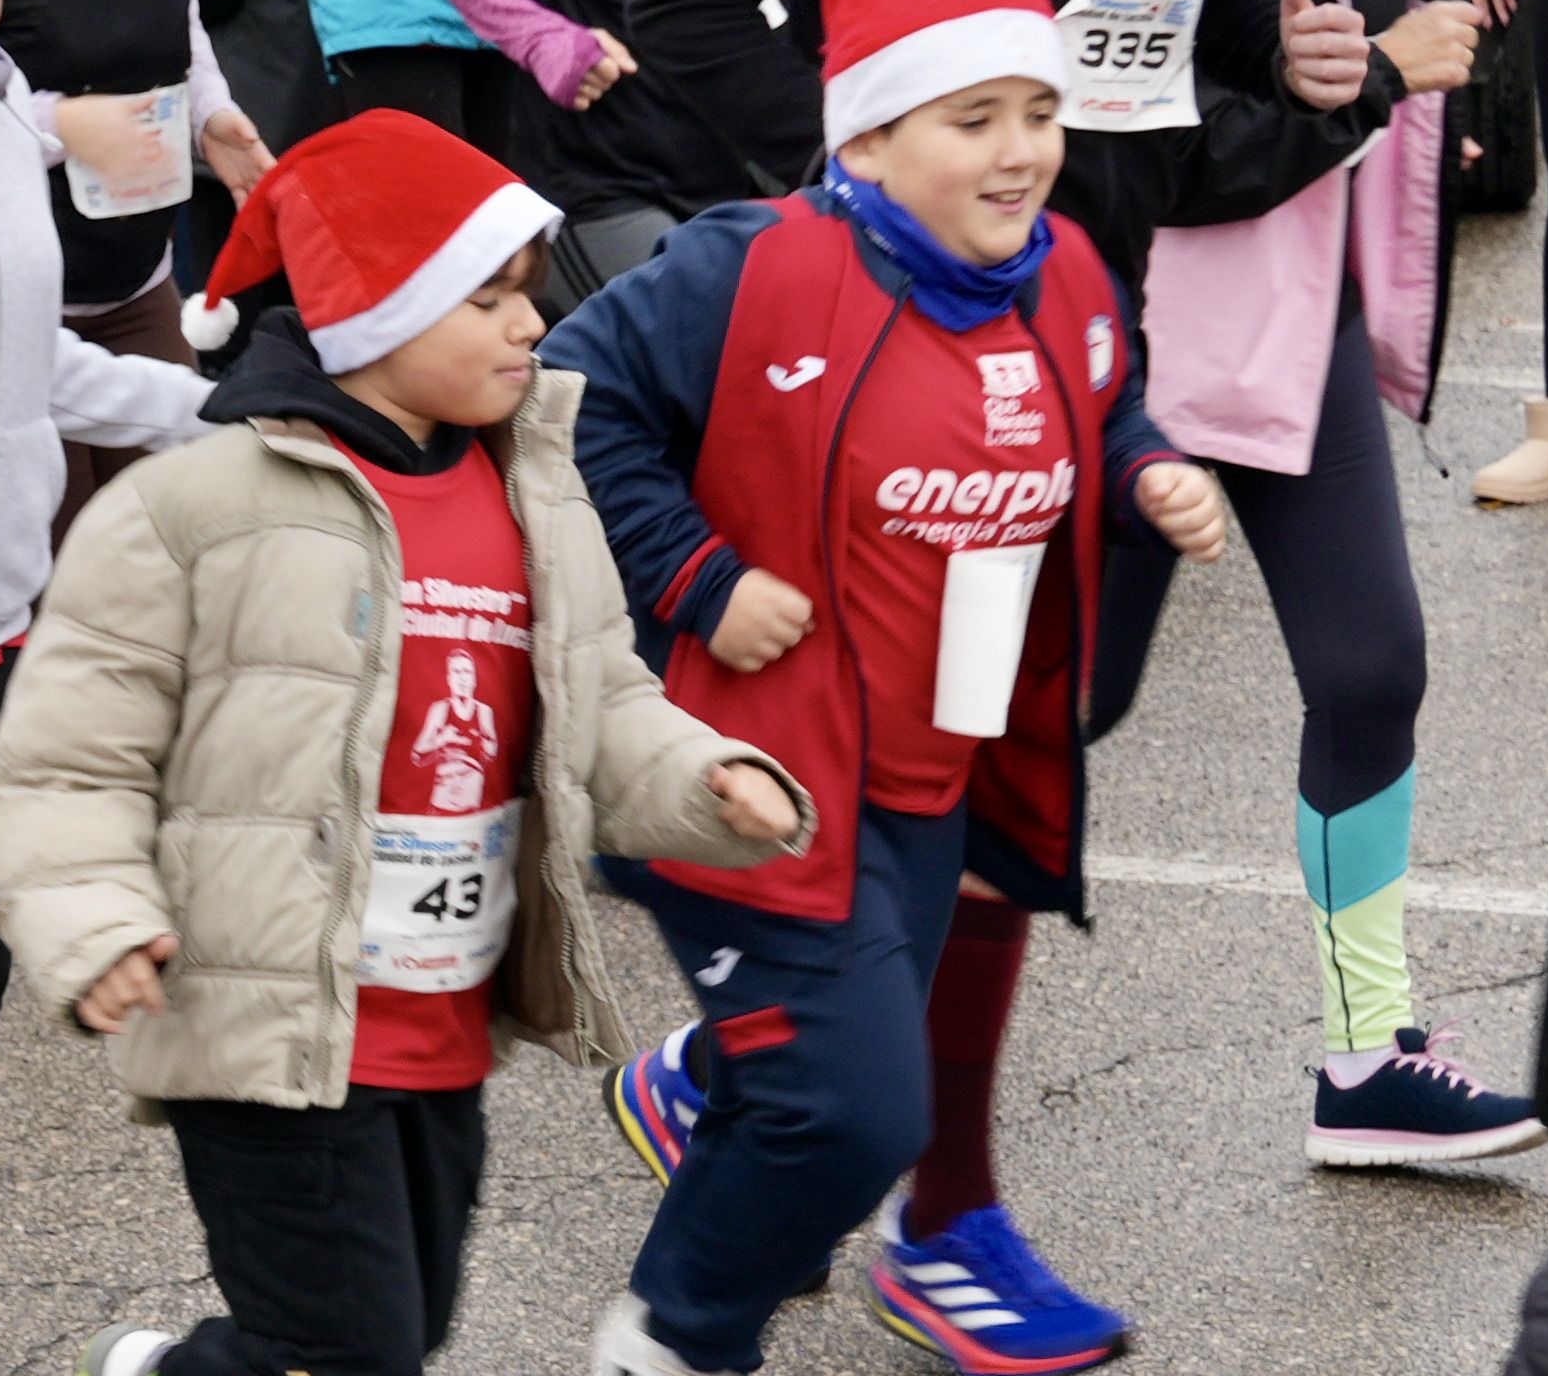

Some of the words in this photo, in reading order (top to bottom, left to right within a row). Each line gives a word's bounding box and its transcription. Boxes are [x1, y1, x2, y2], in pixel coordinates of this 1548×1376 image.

[1079, 29, 1178, 69] 335
[422, 576, 511, 616] Silvestre
[412, 873, 484, 922] 43
